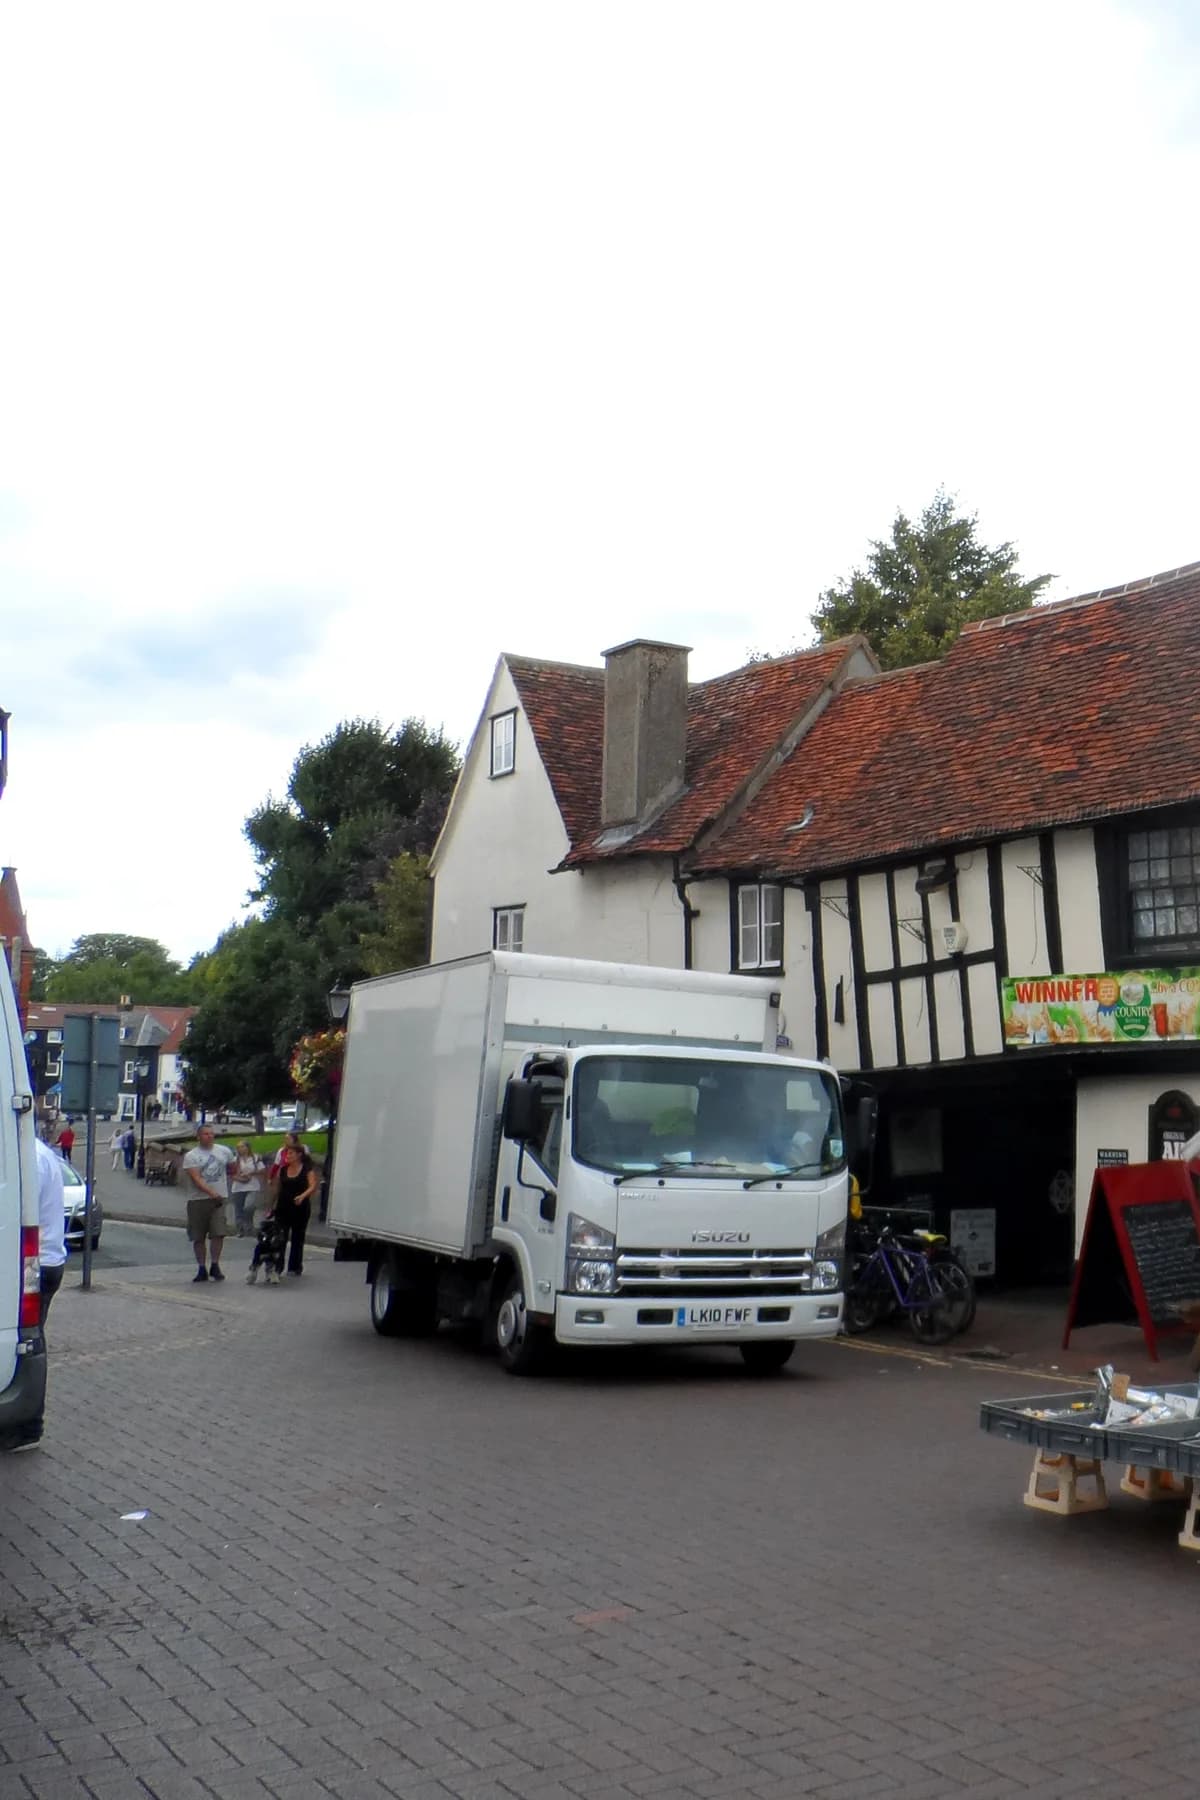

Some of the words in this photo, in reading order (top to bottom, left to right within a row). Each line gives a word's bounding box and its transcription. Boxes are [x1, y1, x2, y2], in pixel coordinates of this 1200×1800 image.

[1115, 1006, 1151, 1018] COUNTRY
[691, 1229, 751, 1243] ISUZU
[690, 1308, 722, 1323] LK10
[724, 1308, 752, 1322] FWF
